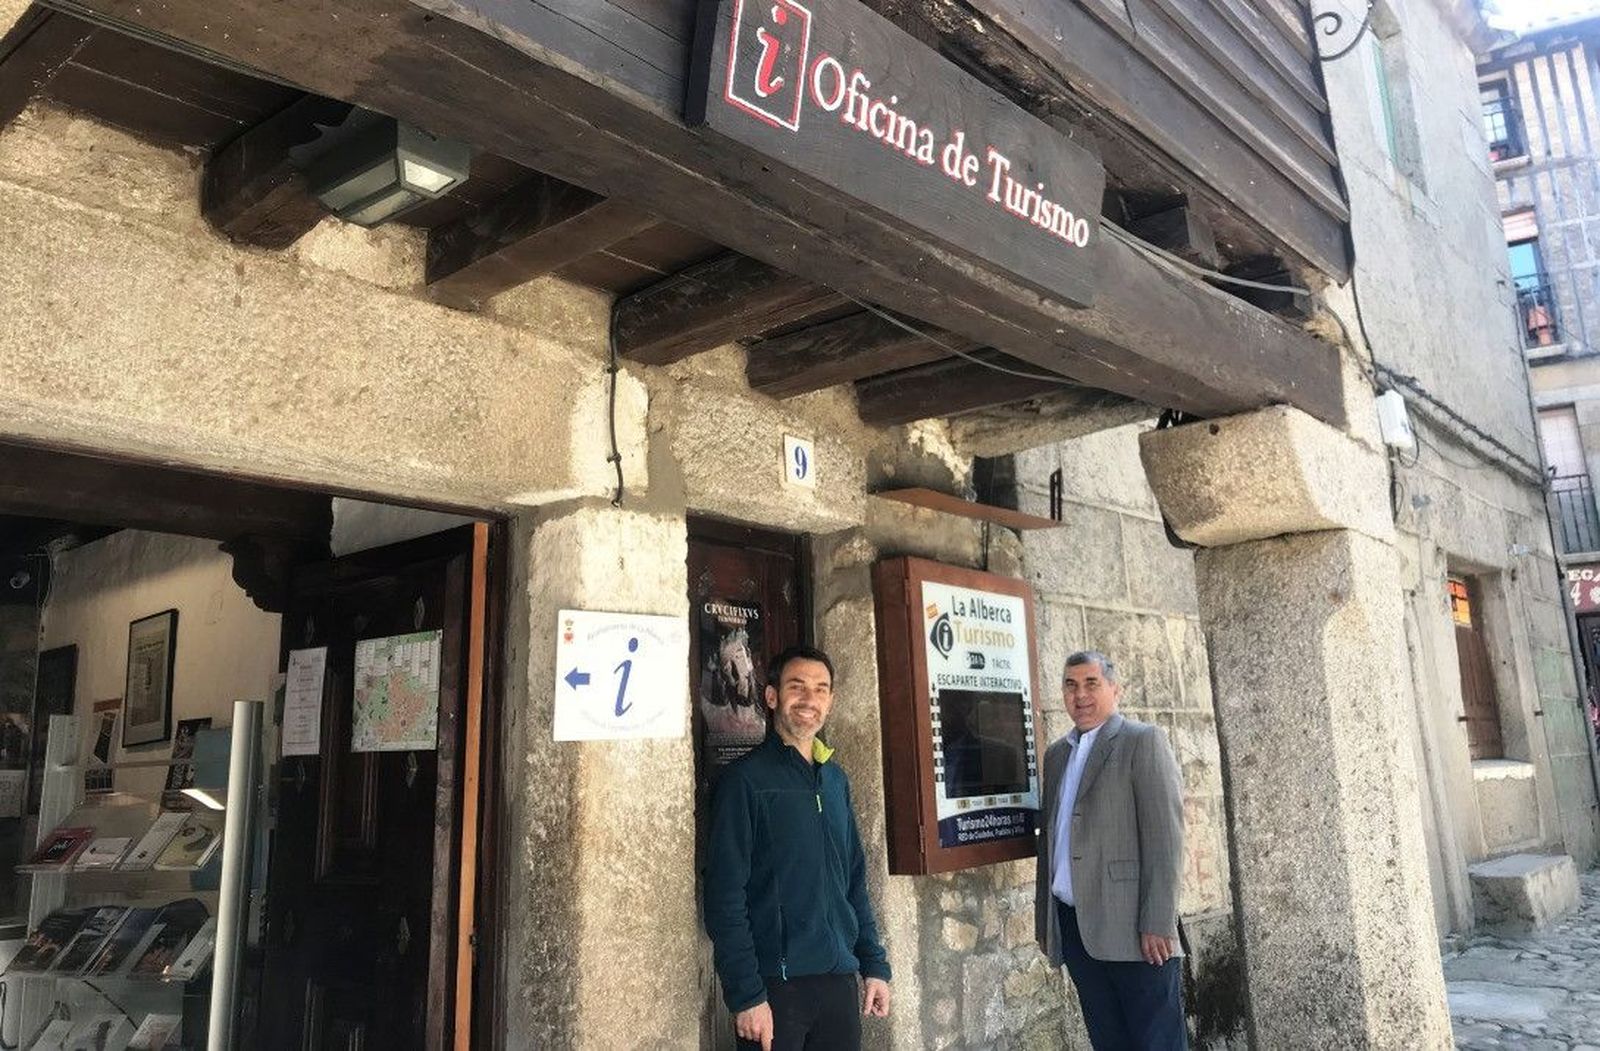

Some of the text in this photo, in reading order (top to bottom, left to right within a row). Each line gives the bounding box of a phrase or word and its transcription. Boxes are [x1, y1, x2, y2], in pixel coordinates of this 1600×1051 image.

[810, 54, 1090, 248] Oficina de Turismo
[795, 446, 807, 480] 9
[952, 595, 1012, 623] La Alberca
[954, 621, 1015, 649] Turismo
[613, 637, 639, 718] i
[937, 673, 1022, 690] ESCAPARTE INTERACTIVO
